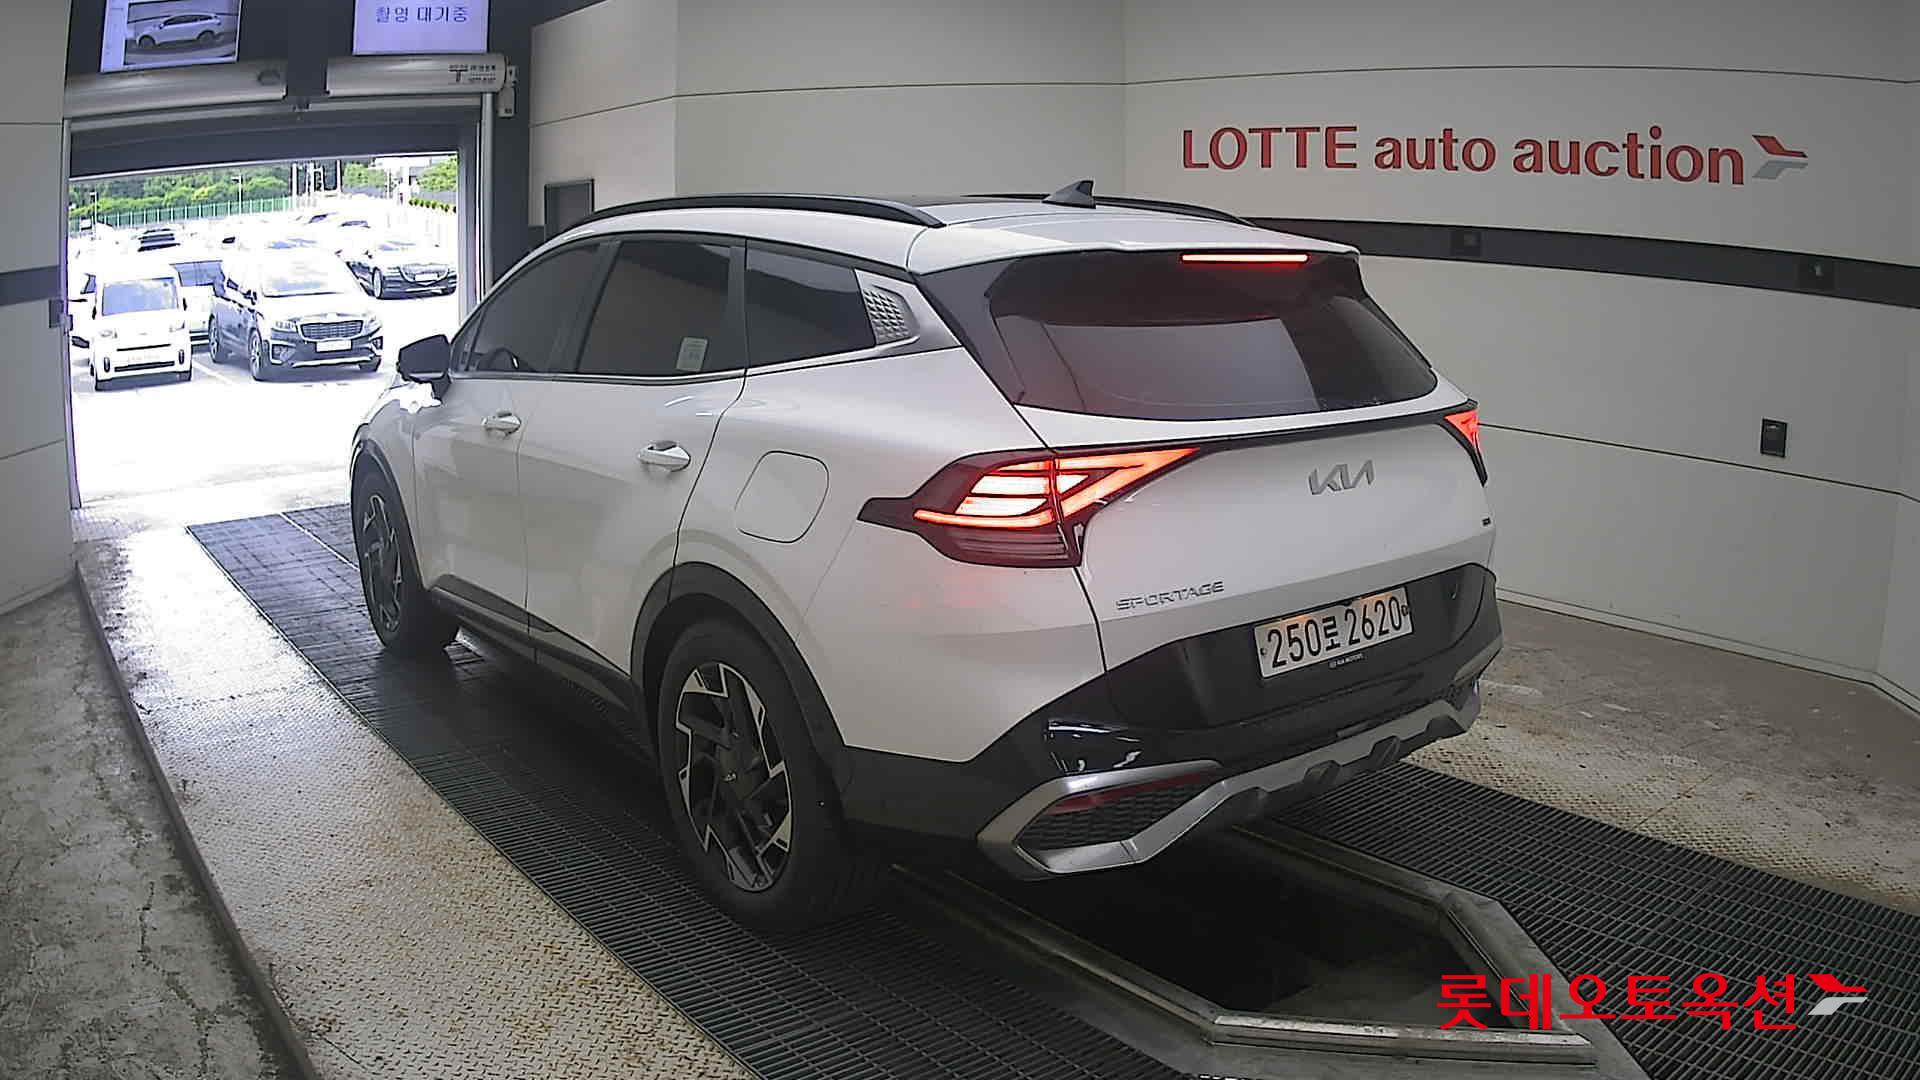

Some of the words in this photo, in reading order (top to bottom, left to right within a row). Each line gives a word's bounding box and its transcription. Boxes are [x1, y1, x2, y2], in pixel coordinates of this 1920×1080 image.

[417, 6, 467, 23] 대기중
[1183, 126, 1357, 170] LOTTE
[1375, 128, 1497, 172] auto
[1513, 126, 1745, 185] auction
[1308, 460, 1375, 495] KIA
[1115, 580, 1225, 610] SPORTAGE
